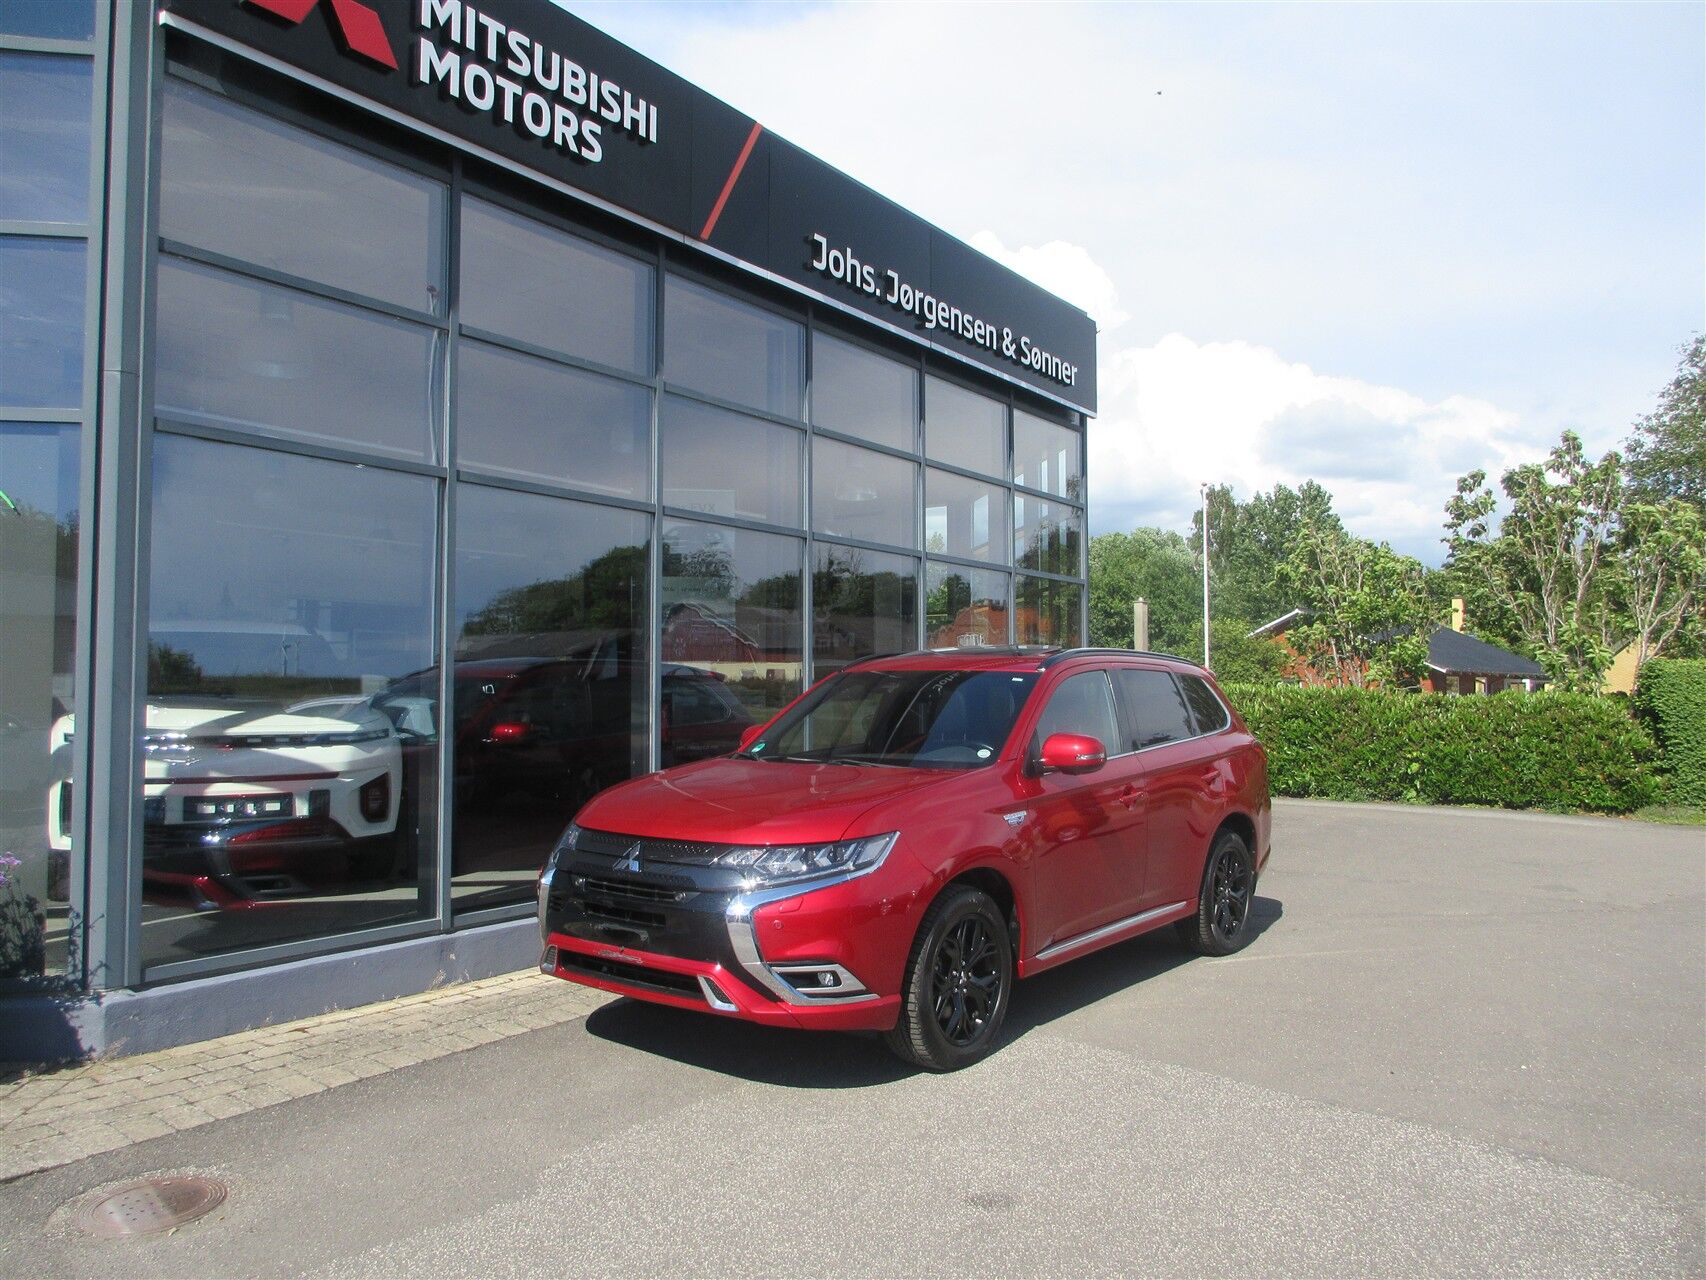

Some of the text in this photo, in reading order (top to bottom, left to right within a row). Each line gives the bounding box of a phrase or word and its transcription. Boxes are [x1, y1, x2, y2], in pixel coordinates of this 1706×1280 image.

[420, 39, 602, 162] MOTORS
[421, 0, 657, 143] MITSUBISHI
[813, 233, 1077, 385] Johs. Jørgensen & Sønner
